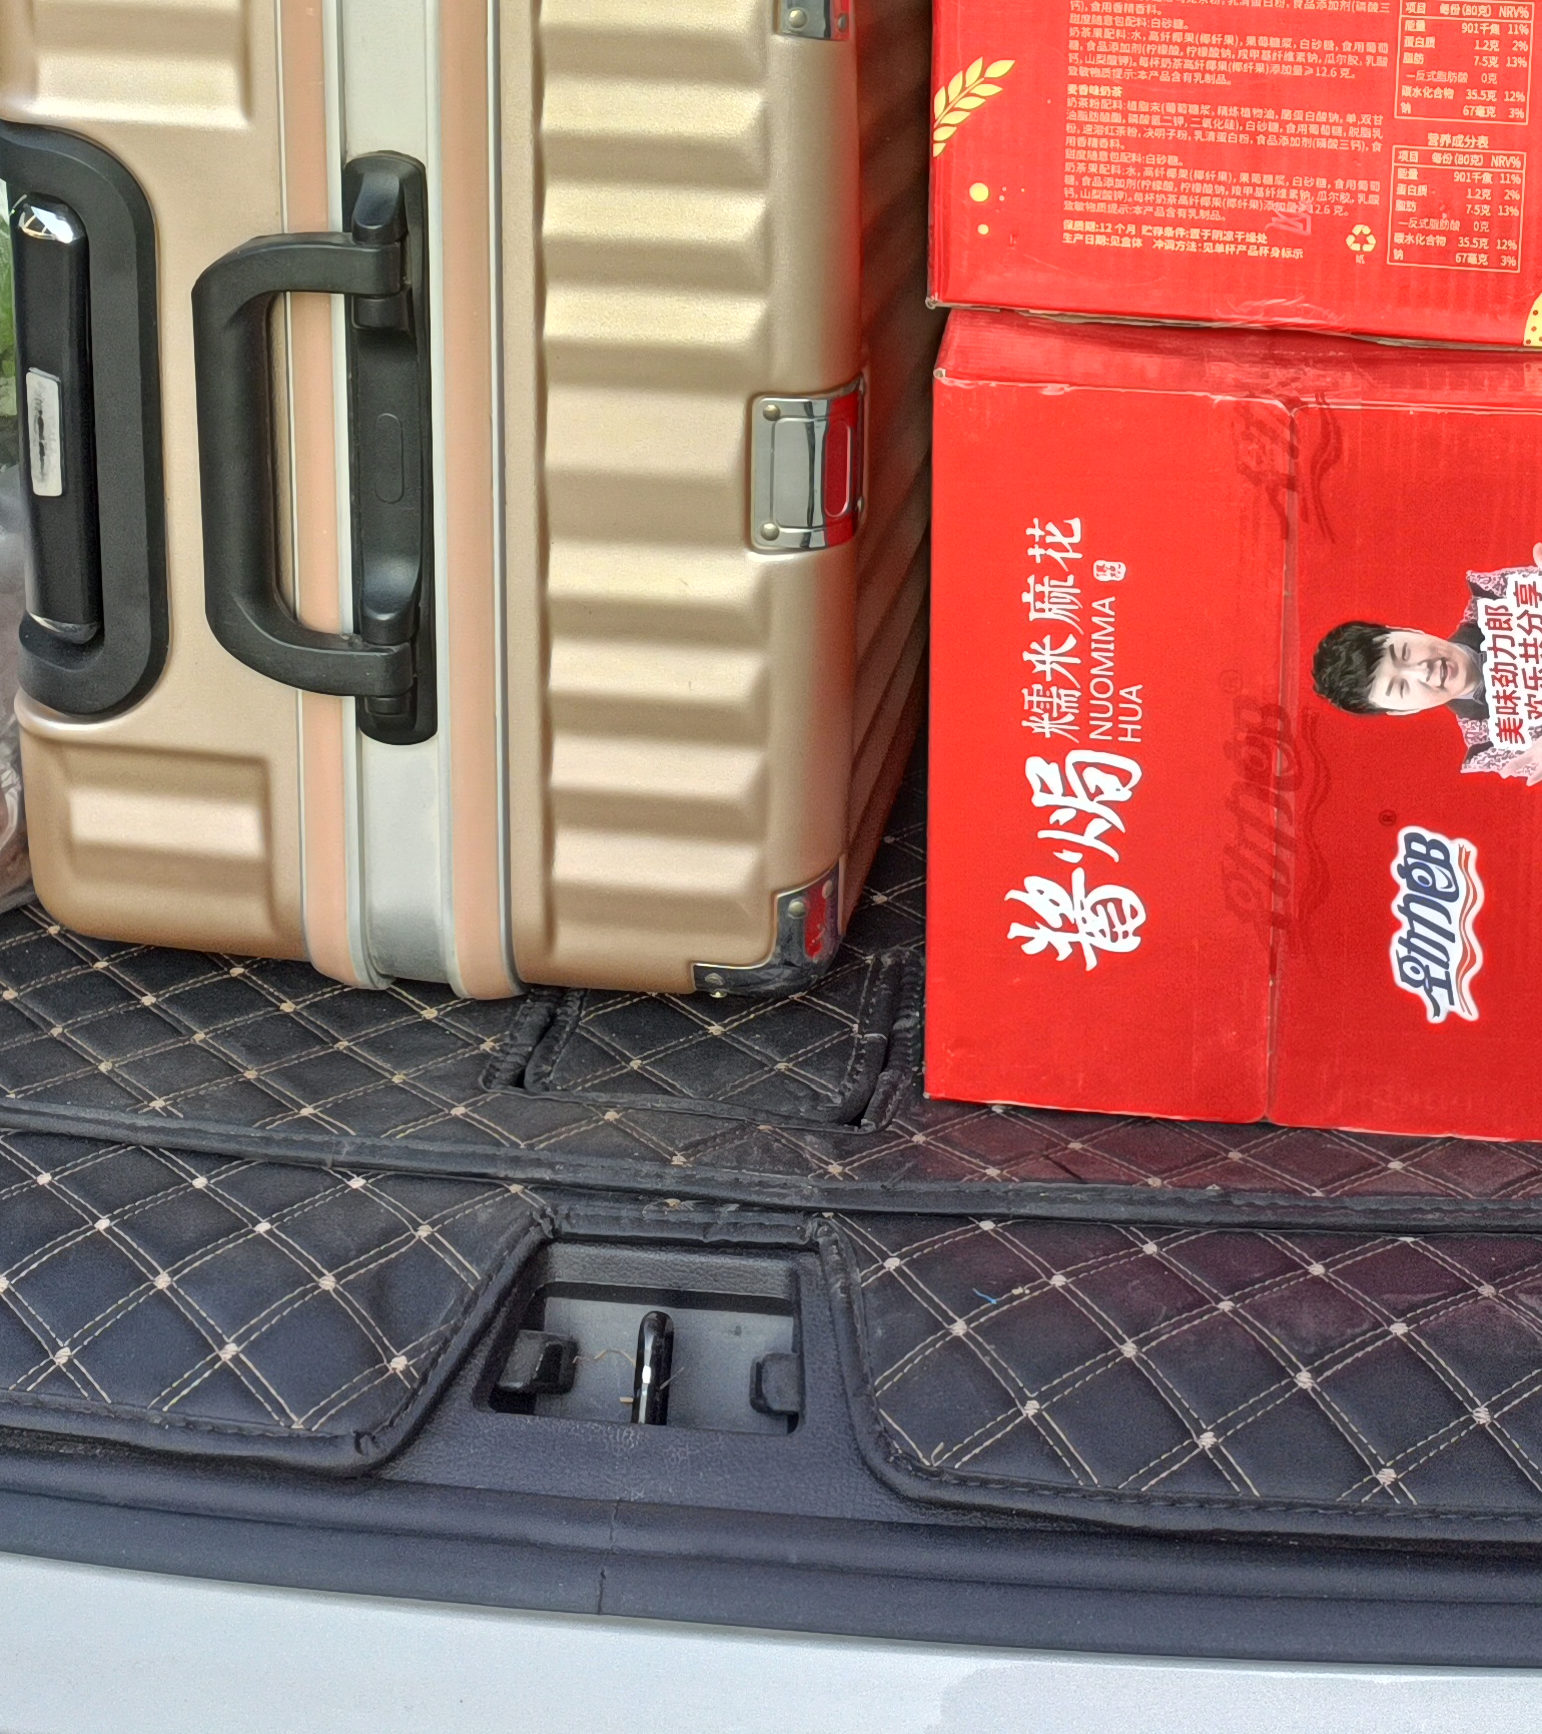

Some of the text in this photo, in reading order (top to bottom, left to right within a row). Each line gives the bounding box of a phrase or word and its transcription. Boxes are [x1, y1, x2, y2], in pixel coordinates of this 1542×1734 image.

[1507, 24, 1529, 36] 11%
[1512, 39, 1528, 51] 2%
[1505, 55, 1527, 67] 13%
[1503, 89, 1525, 102] 12%
[1507, 108, 1524, 119] 3%
[1499, 174, 1521, 186] 11%
[1503, 188, 1520, 200] 2%
[1497, 204, 1519, 216] 13%
[1495, 238, 1517, 250] 12%
[1499, 256, 1516, 267] 3%
[1021, 517, 1084, 744] 糯米麻花
[1089, 596, 1116, 741] NUOMIMA
[1484, 603, 1527, 746] 美味劲力郎
[1117, 684, 1143, 743] HUA
[1395, 830, 1459, 1018] 劲力郎
